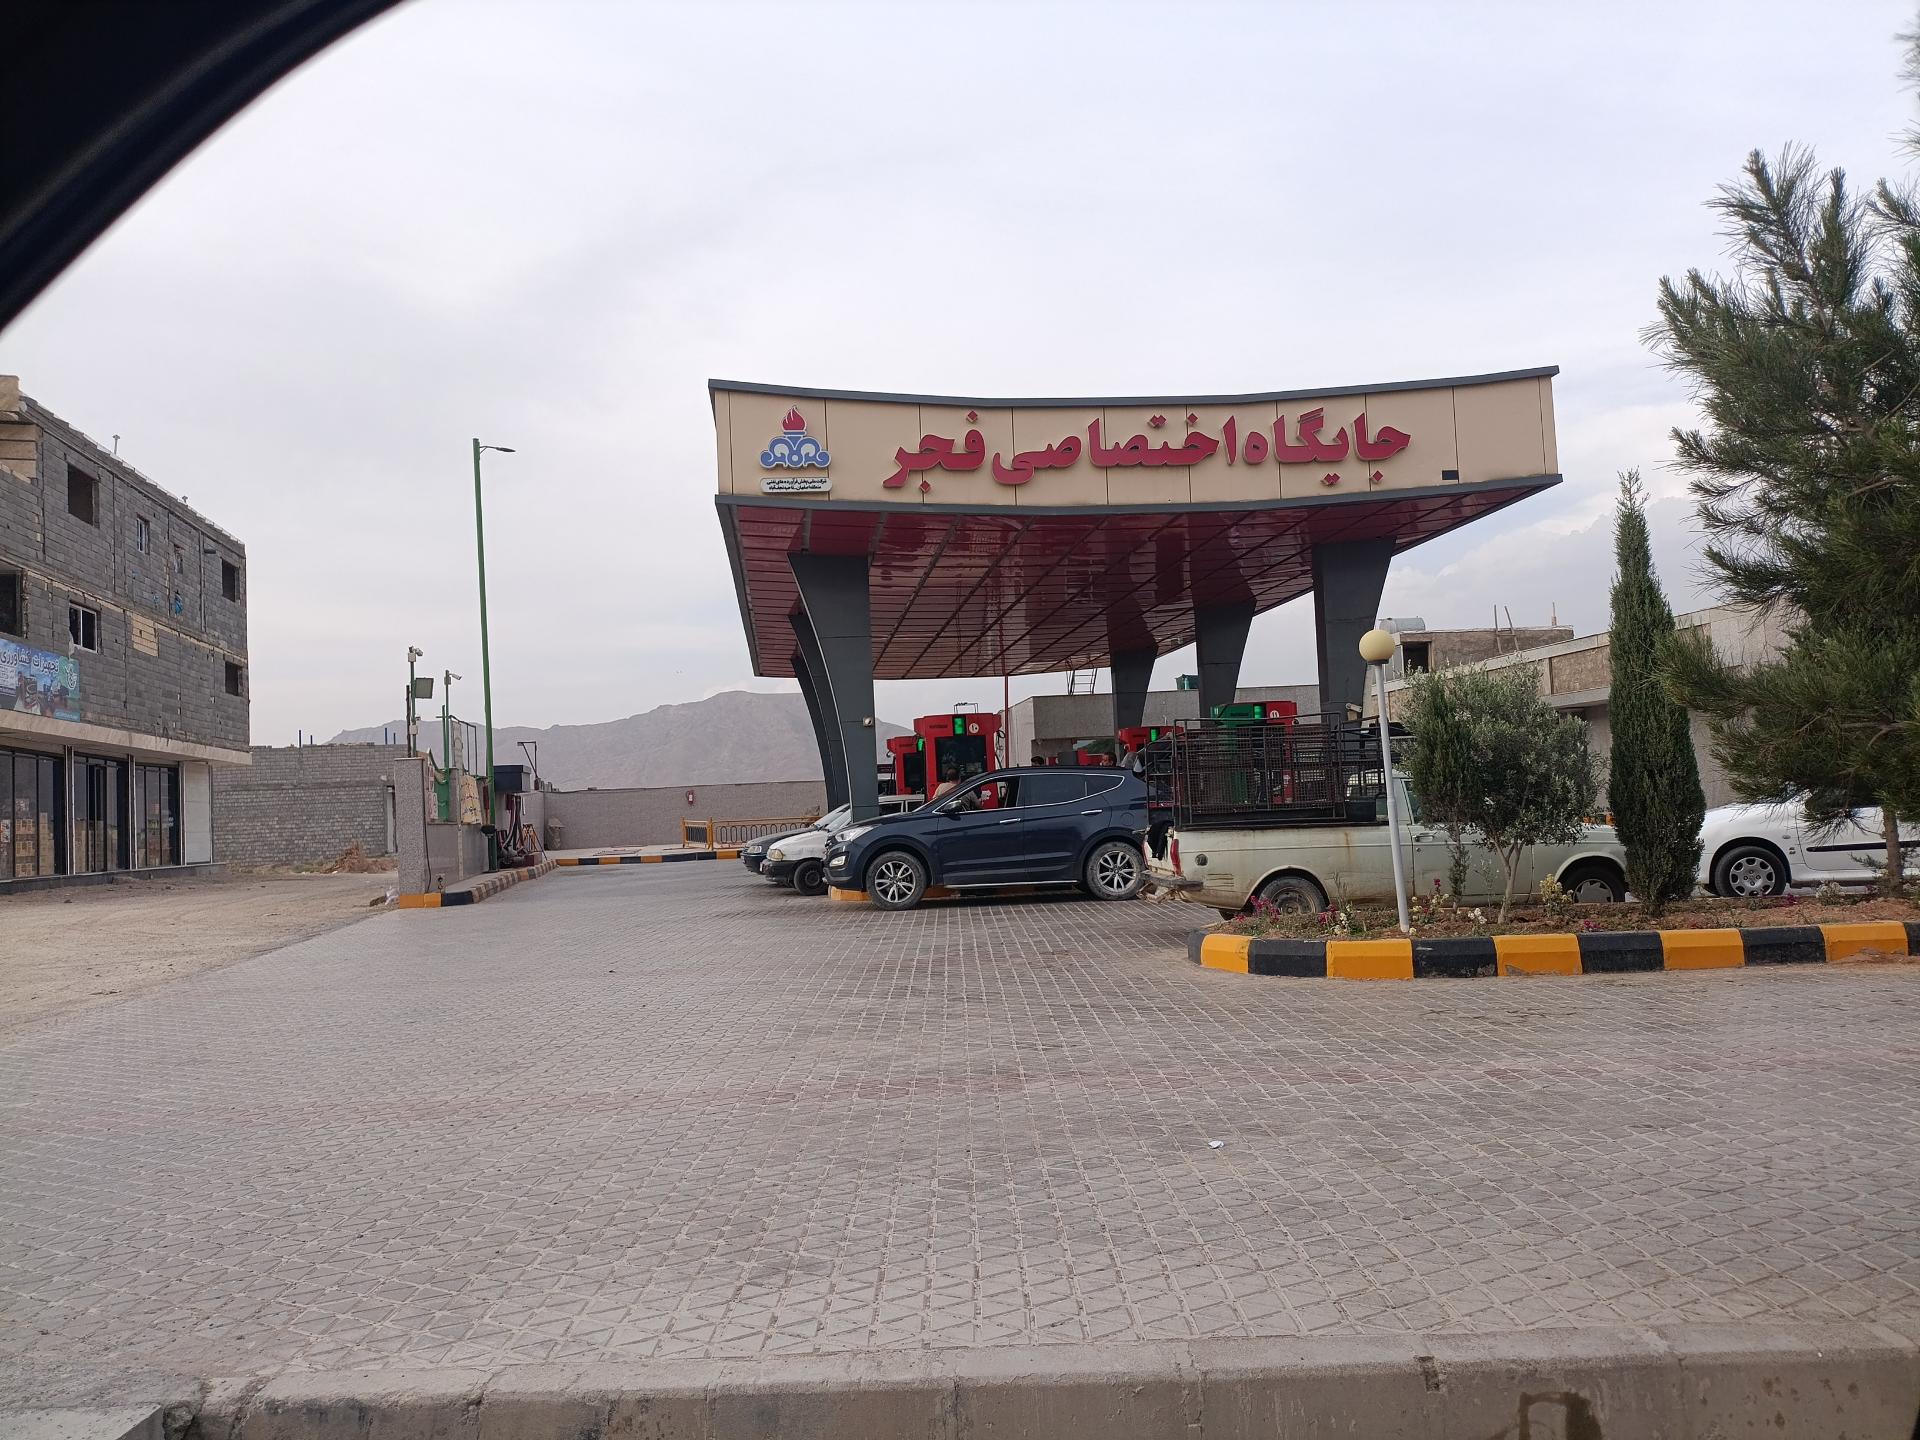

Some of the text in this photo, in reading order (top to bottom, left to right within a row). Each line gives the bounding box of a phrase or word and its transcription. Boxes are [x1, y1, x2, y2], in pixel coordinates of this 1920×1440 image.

[883, 407, 1412, 494] جایگاه اختصاصی فجر
[0, 648, 60, 674] تجهیزات کشاورزی
